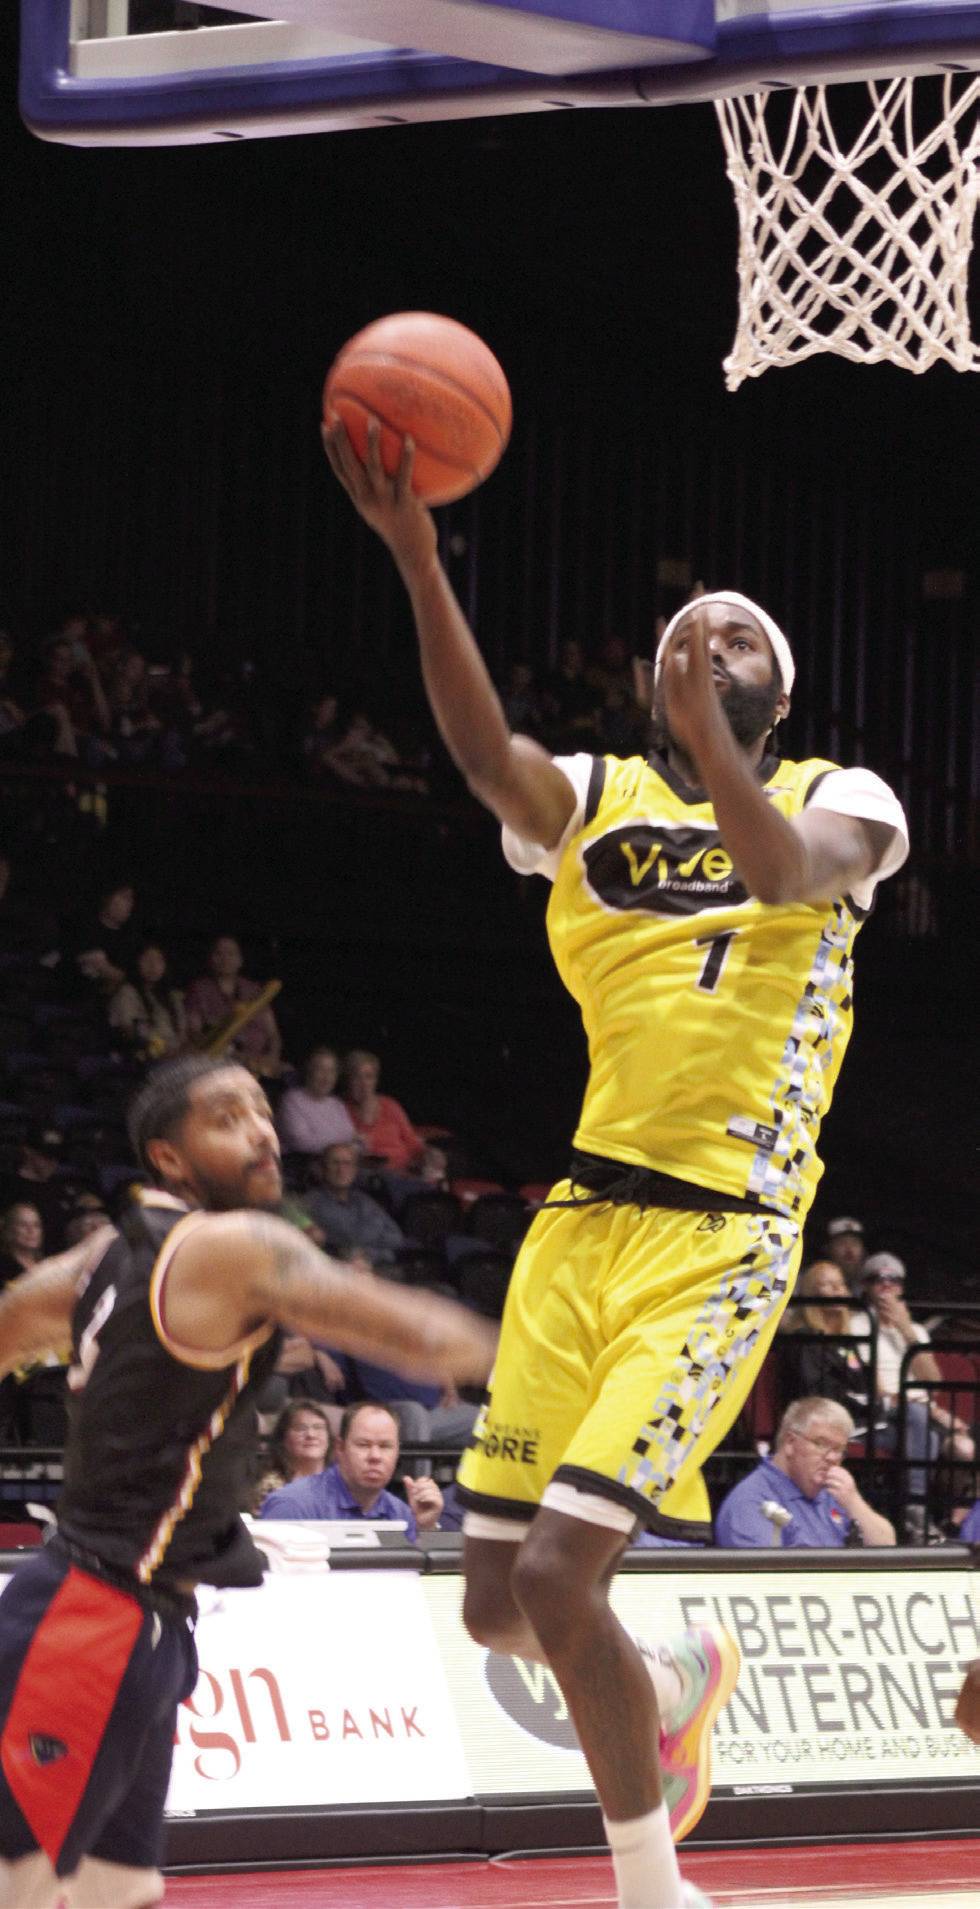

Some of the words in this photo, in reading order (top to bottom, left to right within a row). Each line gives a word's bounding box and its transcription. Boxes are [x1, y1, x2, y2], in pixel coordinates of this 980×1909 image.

[657, 880, 729, 893] broadband
[480, 1433, 538, 1465] ORE
[713, 1661, 974, 1735] NTERNE
[308, 1706, 425, 1740] BANK
[717, 1740, 758, 1764] FOR
[759, 1738, 816, 1762] YOUR
[818, 1735, 876, 1761] HOME
[882, 1734, 921, 1759] AND
